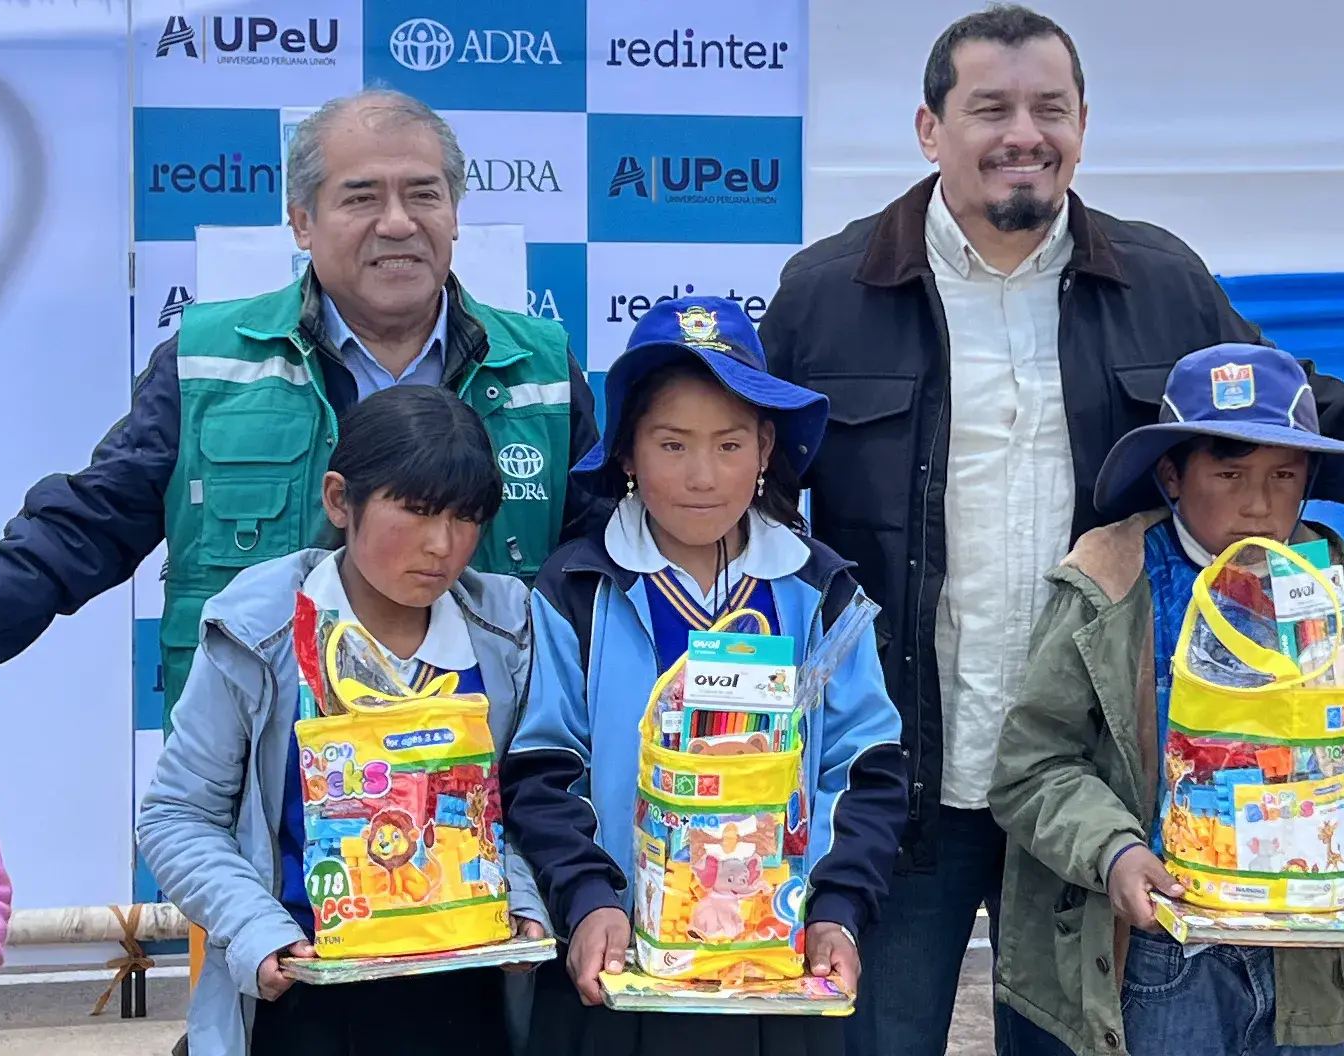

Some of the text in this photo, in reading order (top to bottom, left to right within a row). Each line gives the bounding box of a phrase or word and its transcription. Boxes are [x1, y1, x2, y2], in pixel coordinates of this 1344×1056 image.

[213, 16, 338, 53] UPeU
[458, 30, 562, 64] ADRA
[607, 28, 788, 69] redinter
[217, 56, 269, 65] UNIVERSIDAD
[271, 57, 307, 66] PERUANA
[148, 153, 282, 193] redin
[465, 159, 563, 193] ADRA
[662, 157, 780, 192] UPeU
[502, 483, 548, 500] ADRA
[1289, 582, 1315, 599] oval
[693, 639, 720, 650] oval
[695, 674, 739, 687] oval
[310, 872, 344, 896] 118
[322, 897, 370, 921] PCS
